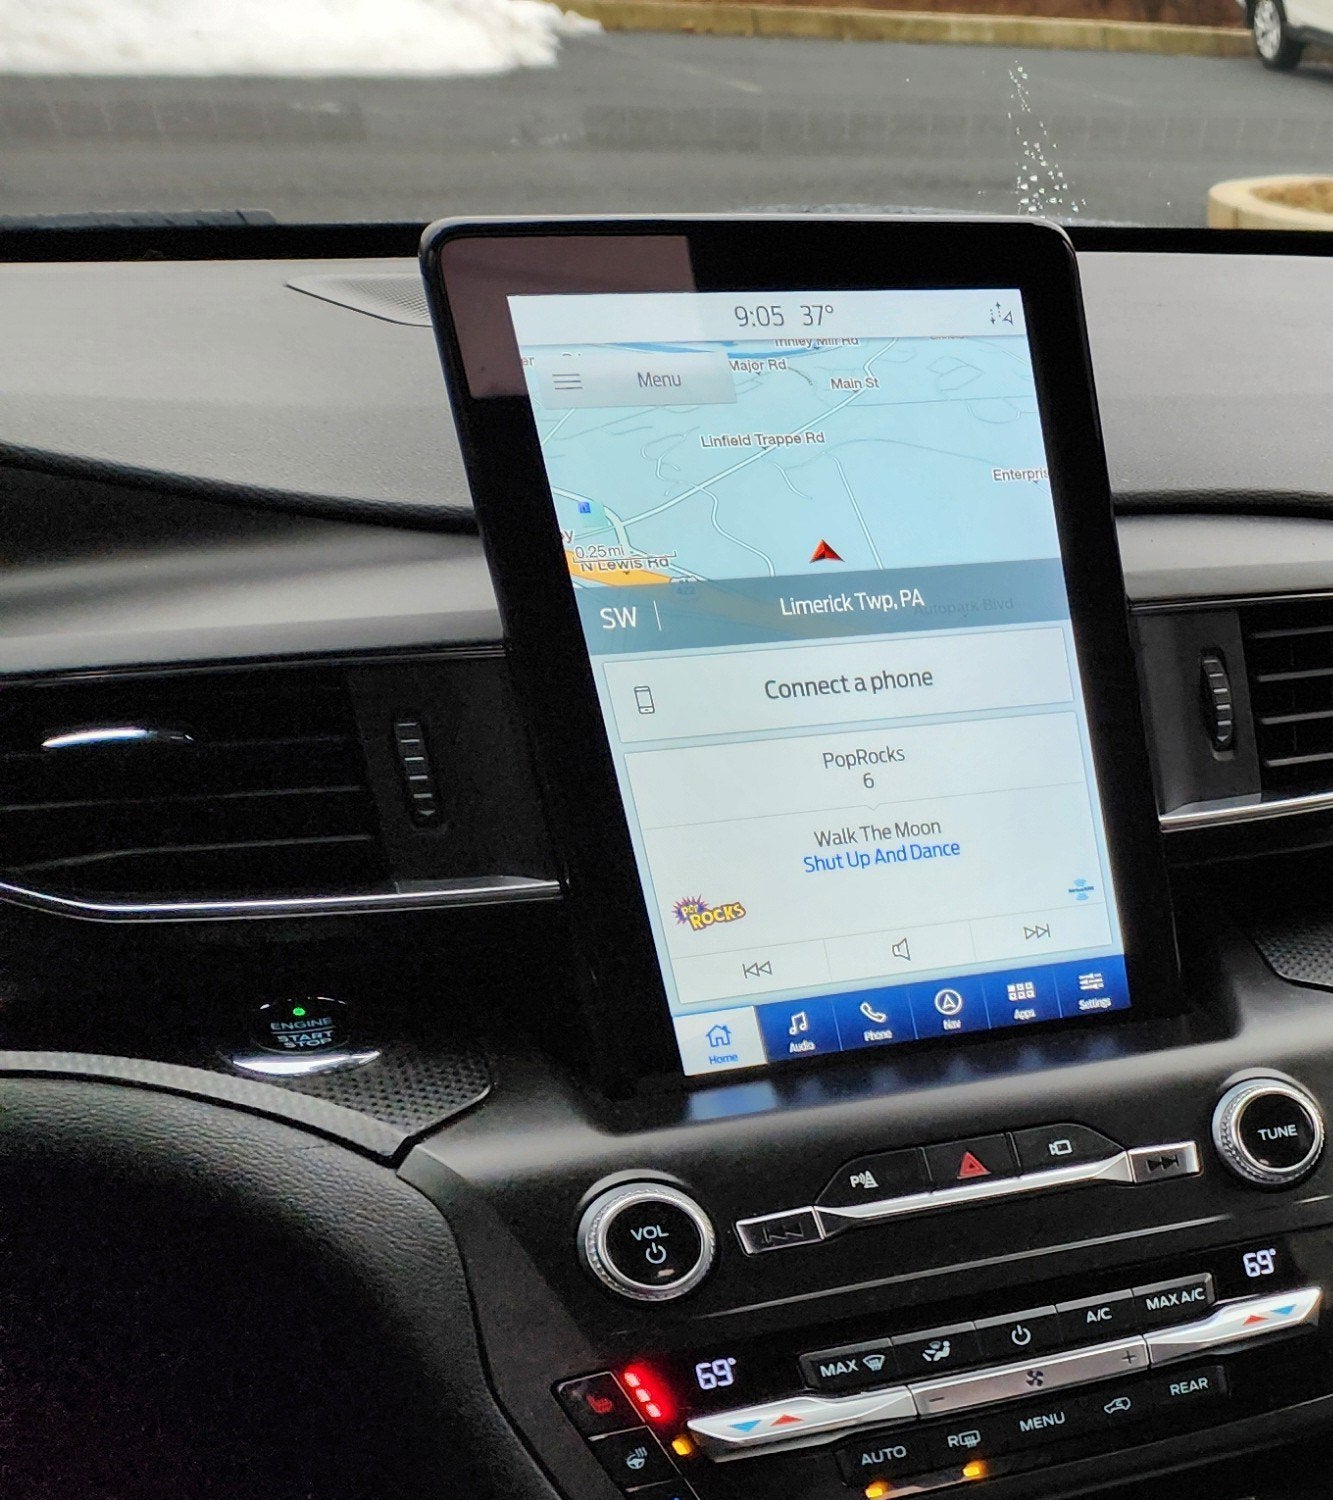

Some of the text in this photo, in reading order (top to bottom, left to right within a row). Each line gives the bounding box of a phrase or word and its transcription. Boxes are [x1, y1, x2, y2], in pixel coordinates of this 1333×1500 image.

[734, 304, 834, 327] 9:05 37°
[729, 359, 787, 373] Major Rd
[638, 372, 682, 388] Menu
[830, 377, 880, 390] Main St
[701, 431, 826, 448] Linfield Trappe Rd
[780, 588, 925, 616] Limerick Twp, PA
[600, 606, 636, 629] SW
[765, 670, 933, 699] Connect a phone
[822, 746, 906, 770] PopRocks
[863, 772, 875, 789] 6
[814, 821, 942, 848] Walk The Moon
[803, 842, 961, 873] Shut Up And Dance
[690, 903, 745, 929] ROCKS
[270, 1016, 333, 1030] ENGINE
[277, 1030, 335, 1042] START
[283, 1037, 333, 1048] STOP
[863, 1030, 893, 1042] Phone
[789, 1039, 816, 1053] Audio
[709, 1053, 738, 1065] Home
[1257, 1124, 1298, 1140] TUNE
[630, 1224, 669, 1240] VOL
[1146, 1287, 1206, 1311] MAX A/C
[1086, 1306, 1113, 1325] A/C
[820, 1358, 859, 1378] MAX
[1169, 1376, 1208, 1396] REAR
[1019, 1411, 1066, 1432] MENU
[861, 1445, 907, 1466] AUTO
